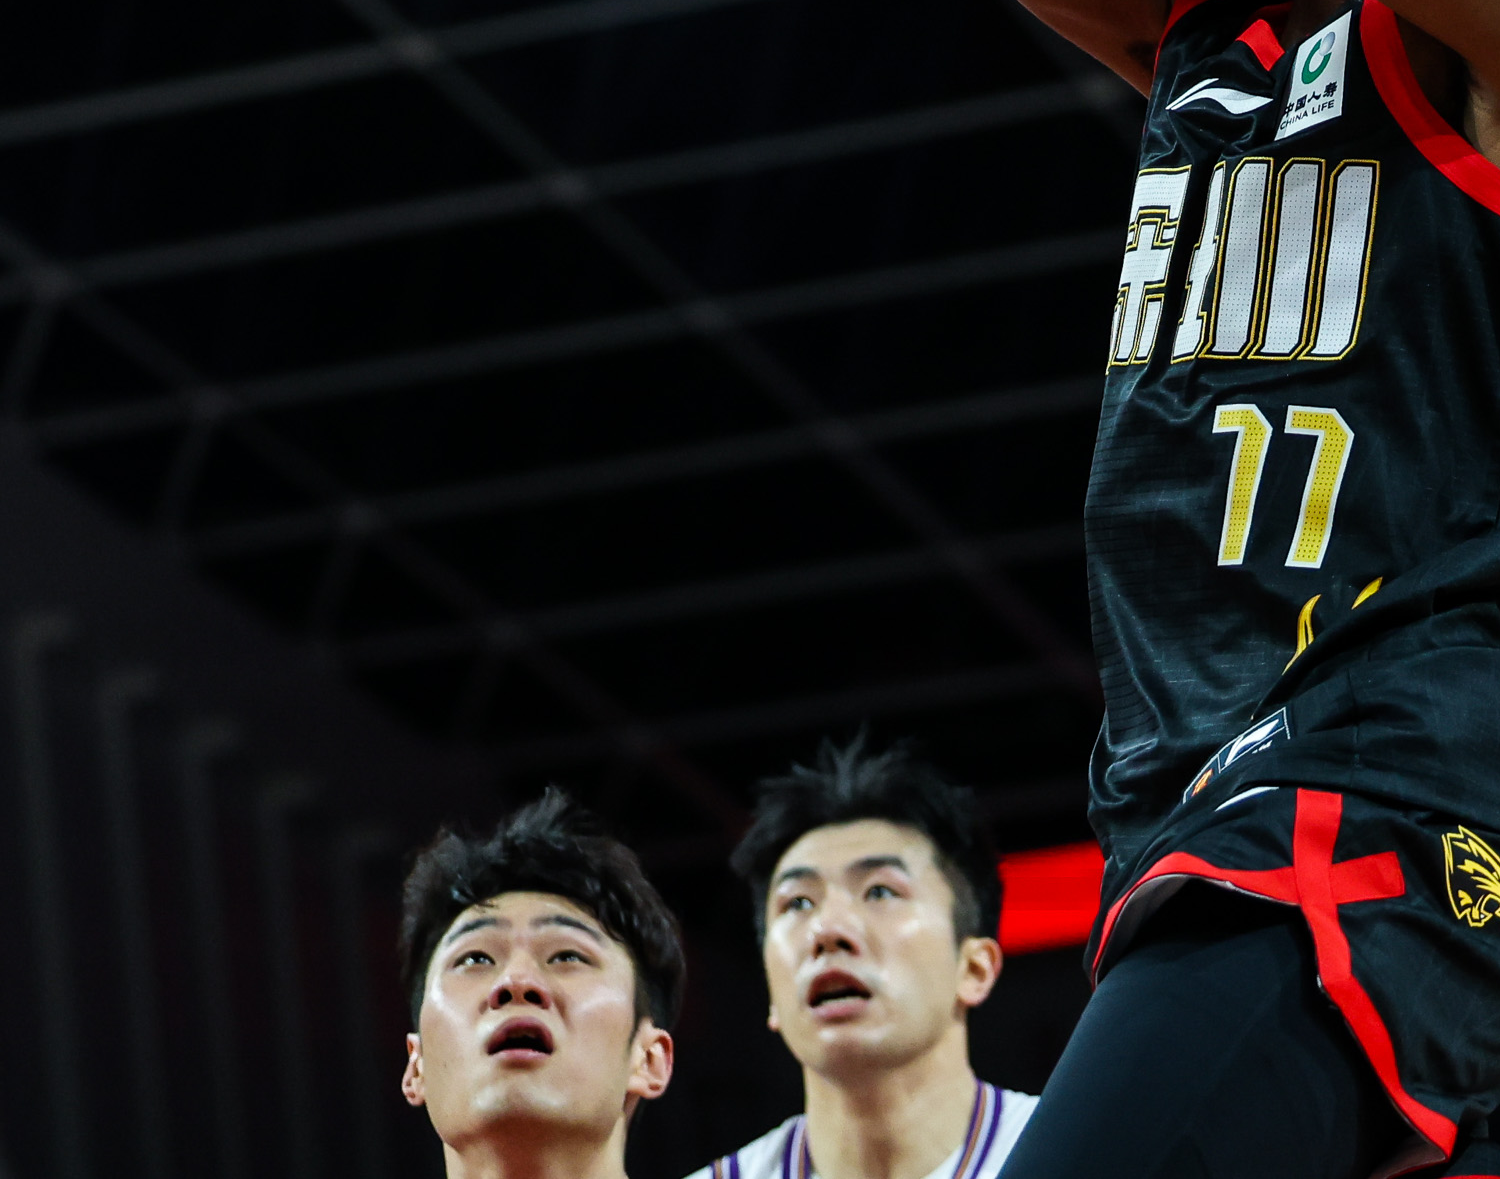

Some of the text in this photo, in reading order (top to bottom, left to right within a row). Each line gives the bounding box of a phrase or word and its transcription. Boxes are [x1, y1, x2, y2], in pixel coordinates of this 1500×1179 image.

[1280, 99, 1335, 130] CHINA LIFE
[1282, 81, 1338, 118] 中国人寿
